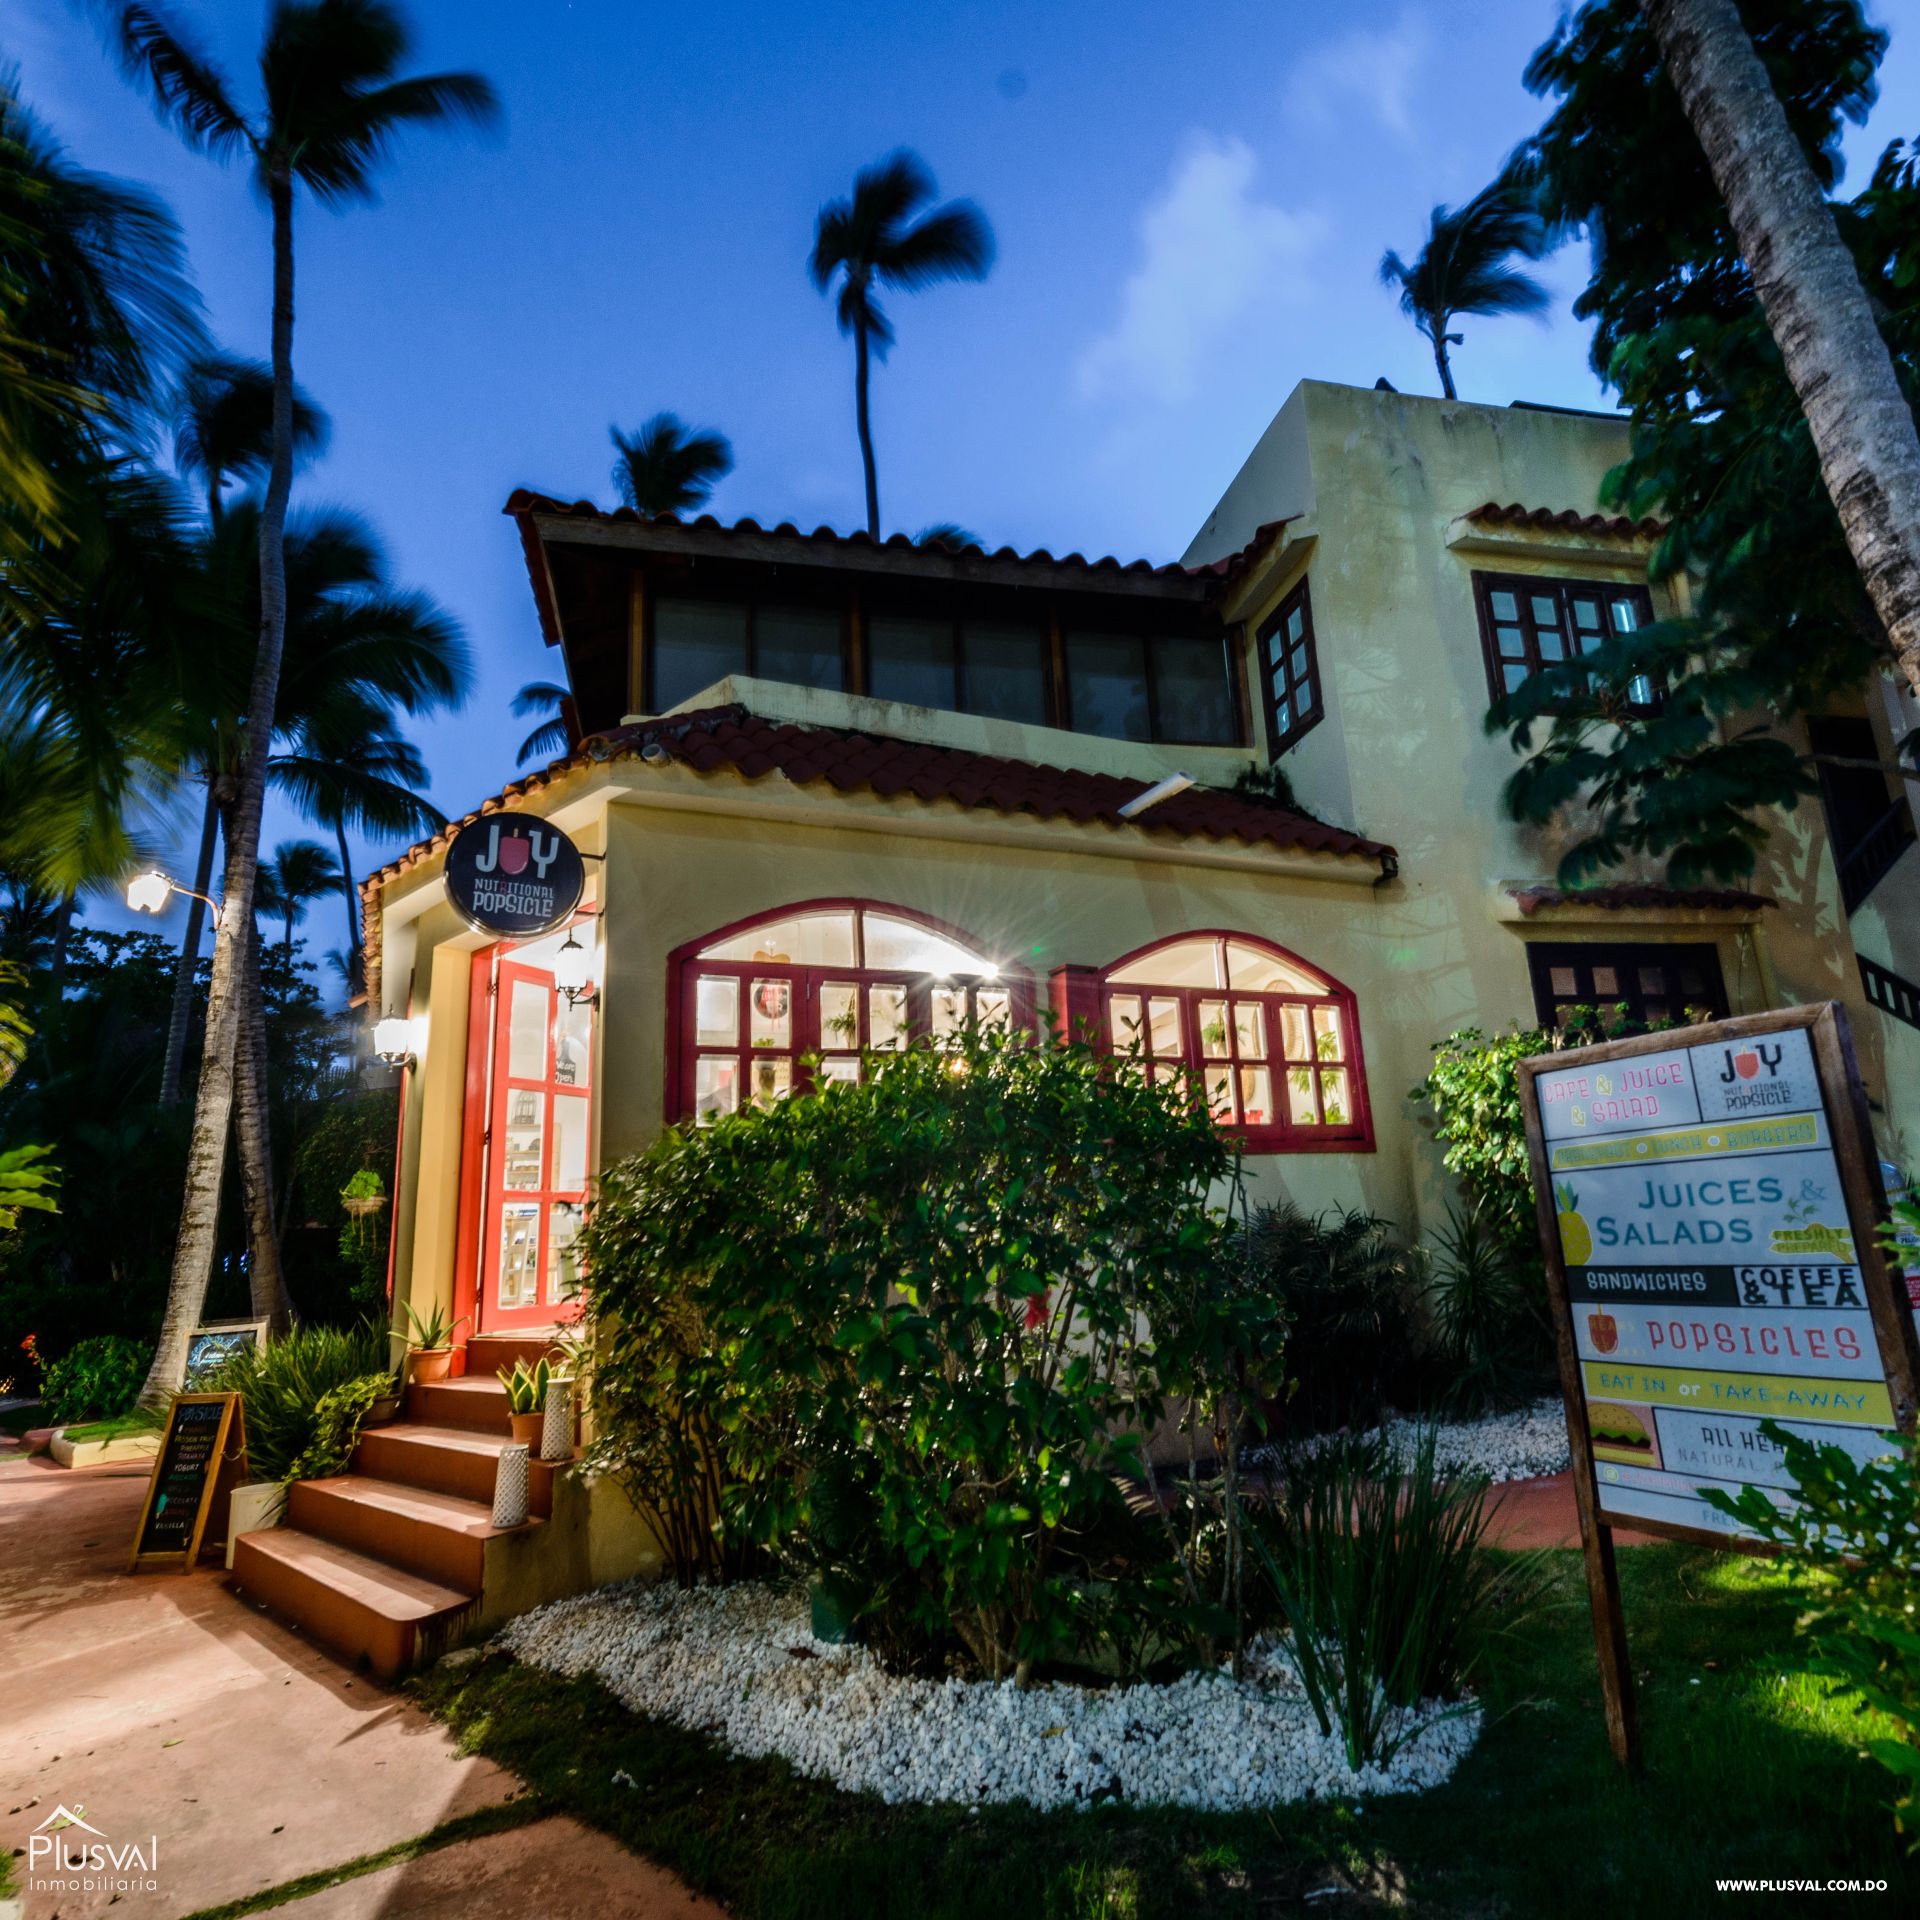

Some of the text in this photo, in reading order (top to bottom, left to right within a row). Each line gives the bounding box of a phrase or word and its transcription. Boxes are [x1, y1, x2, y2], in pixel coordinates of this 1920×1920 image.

[474, 878, 555, 899] NUTRITIONAL
[472, 891, 554, 917] POPSICLE
[1543, 1077, 1591, 1103] CAFE
[1619, 1062, 1685, 1092] JUICE
[1591, 1095, 1660, 1123] SALAD
[1726, 1089, 1792, 1111] POPSICLE
[1637, 1177, 1827, 1210] JUICES &
[1595, 1216, 1754, 1247] SALADS
[1586, 1271, 1707, 1292] SANDWICHES
[1740, 1268, 1856, 1287] COFFEE
[1743, 1282, 1862, 1307] & TEA
[1645, 1320, 1862, 1360] POPSICLES
[1600, 1373, 1634, 1391] EAT
[1643, 1376, 1666, 1393] IN
[1679, 1383, 1701, 1396] or
[1701, 1426, 1734, 1449] ALL
[1677, 1446, 1760, 1471] NATURAL
